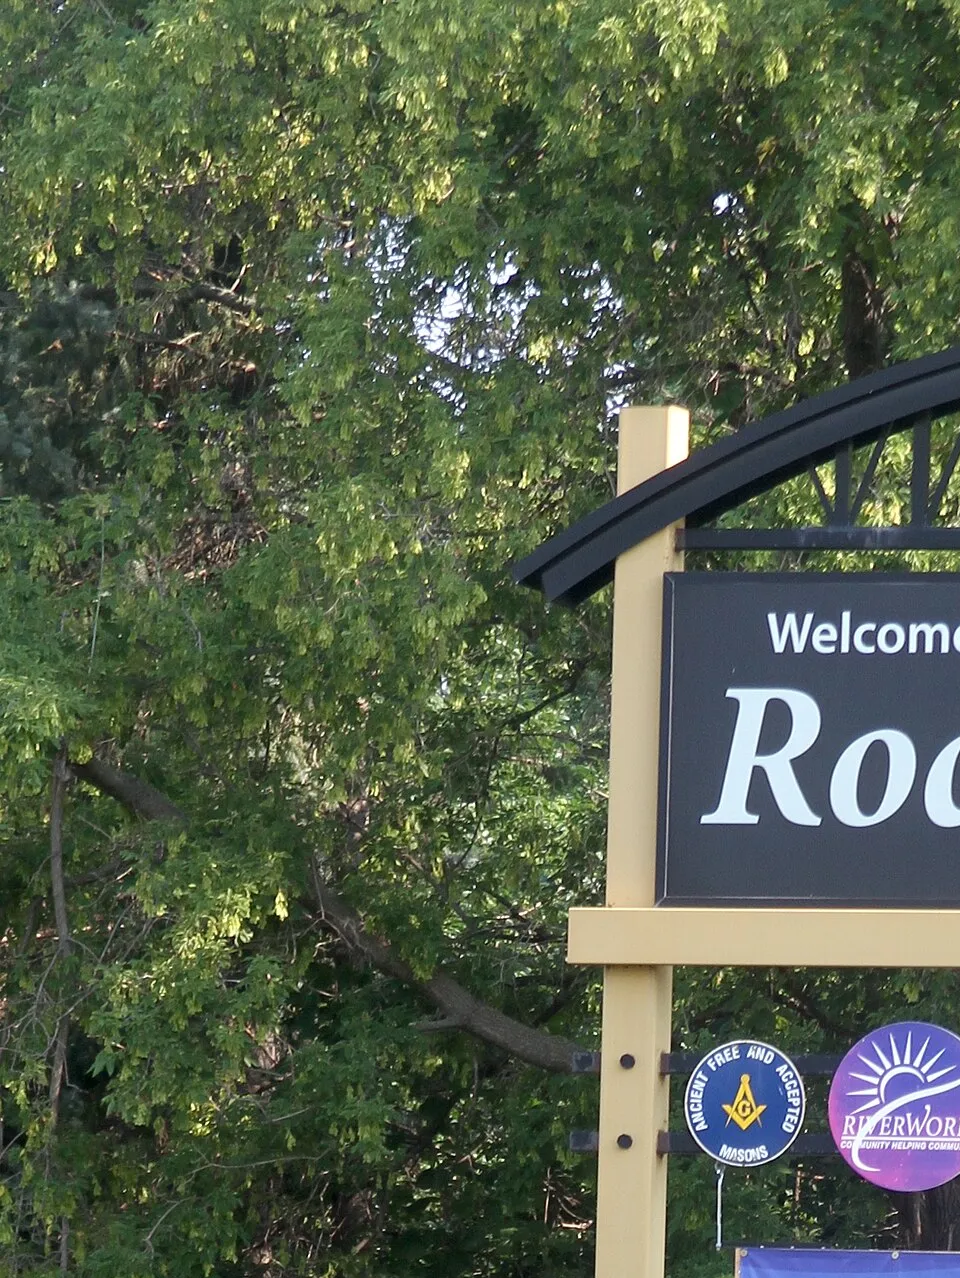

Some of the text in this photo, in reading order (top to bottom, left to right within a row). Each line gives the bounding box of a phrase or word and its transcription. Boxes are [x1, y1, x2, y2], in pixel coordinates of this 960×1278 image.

[690, 1045, 801, 1134] ANCIENT FREE AND ACCEPTED
[738, 1100, 751, 1117] G
[719, 1143, 769, 1163] MASONS
[840, 1140, 890, 1150] COMUNITY
[891, 1141, 926, 1151] HELPING
